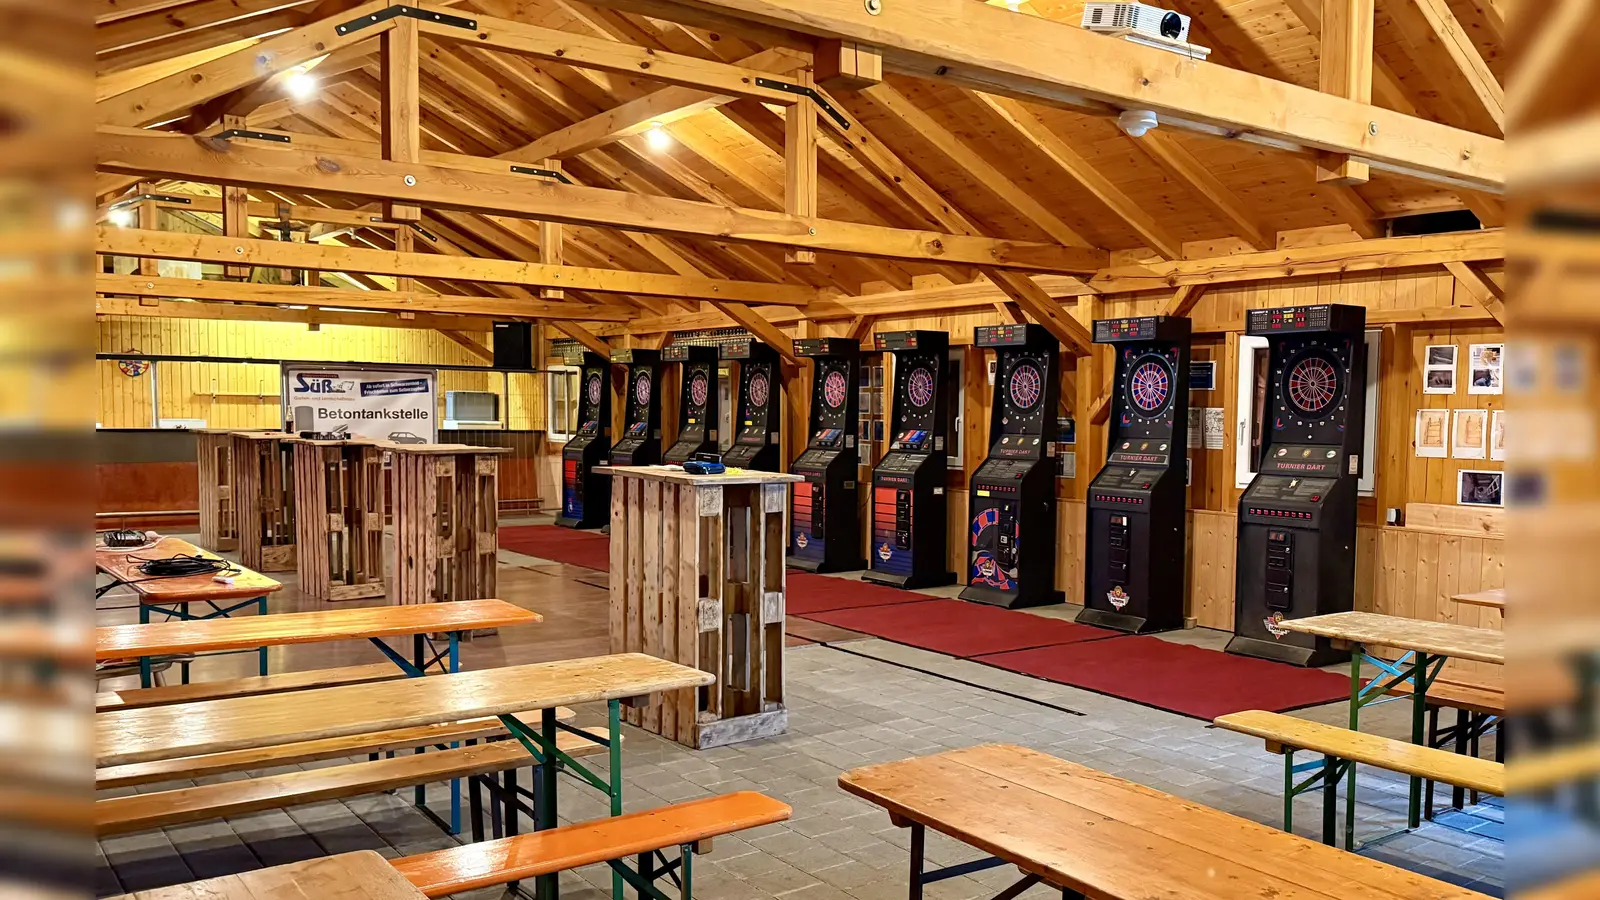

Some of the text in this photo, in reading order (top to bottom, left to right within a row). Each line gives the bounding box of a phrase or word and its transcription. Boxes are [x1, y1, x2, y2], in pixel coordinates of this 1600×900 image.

[294, 373, 334, 393] Süß
[318, 408, 429, 419] Betontankstelle
[1277, 462, 1305, 470] TURNIER
